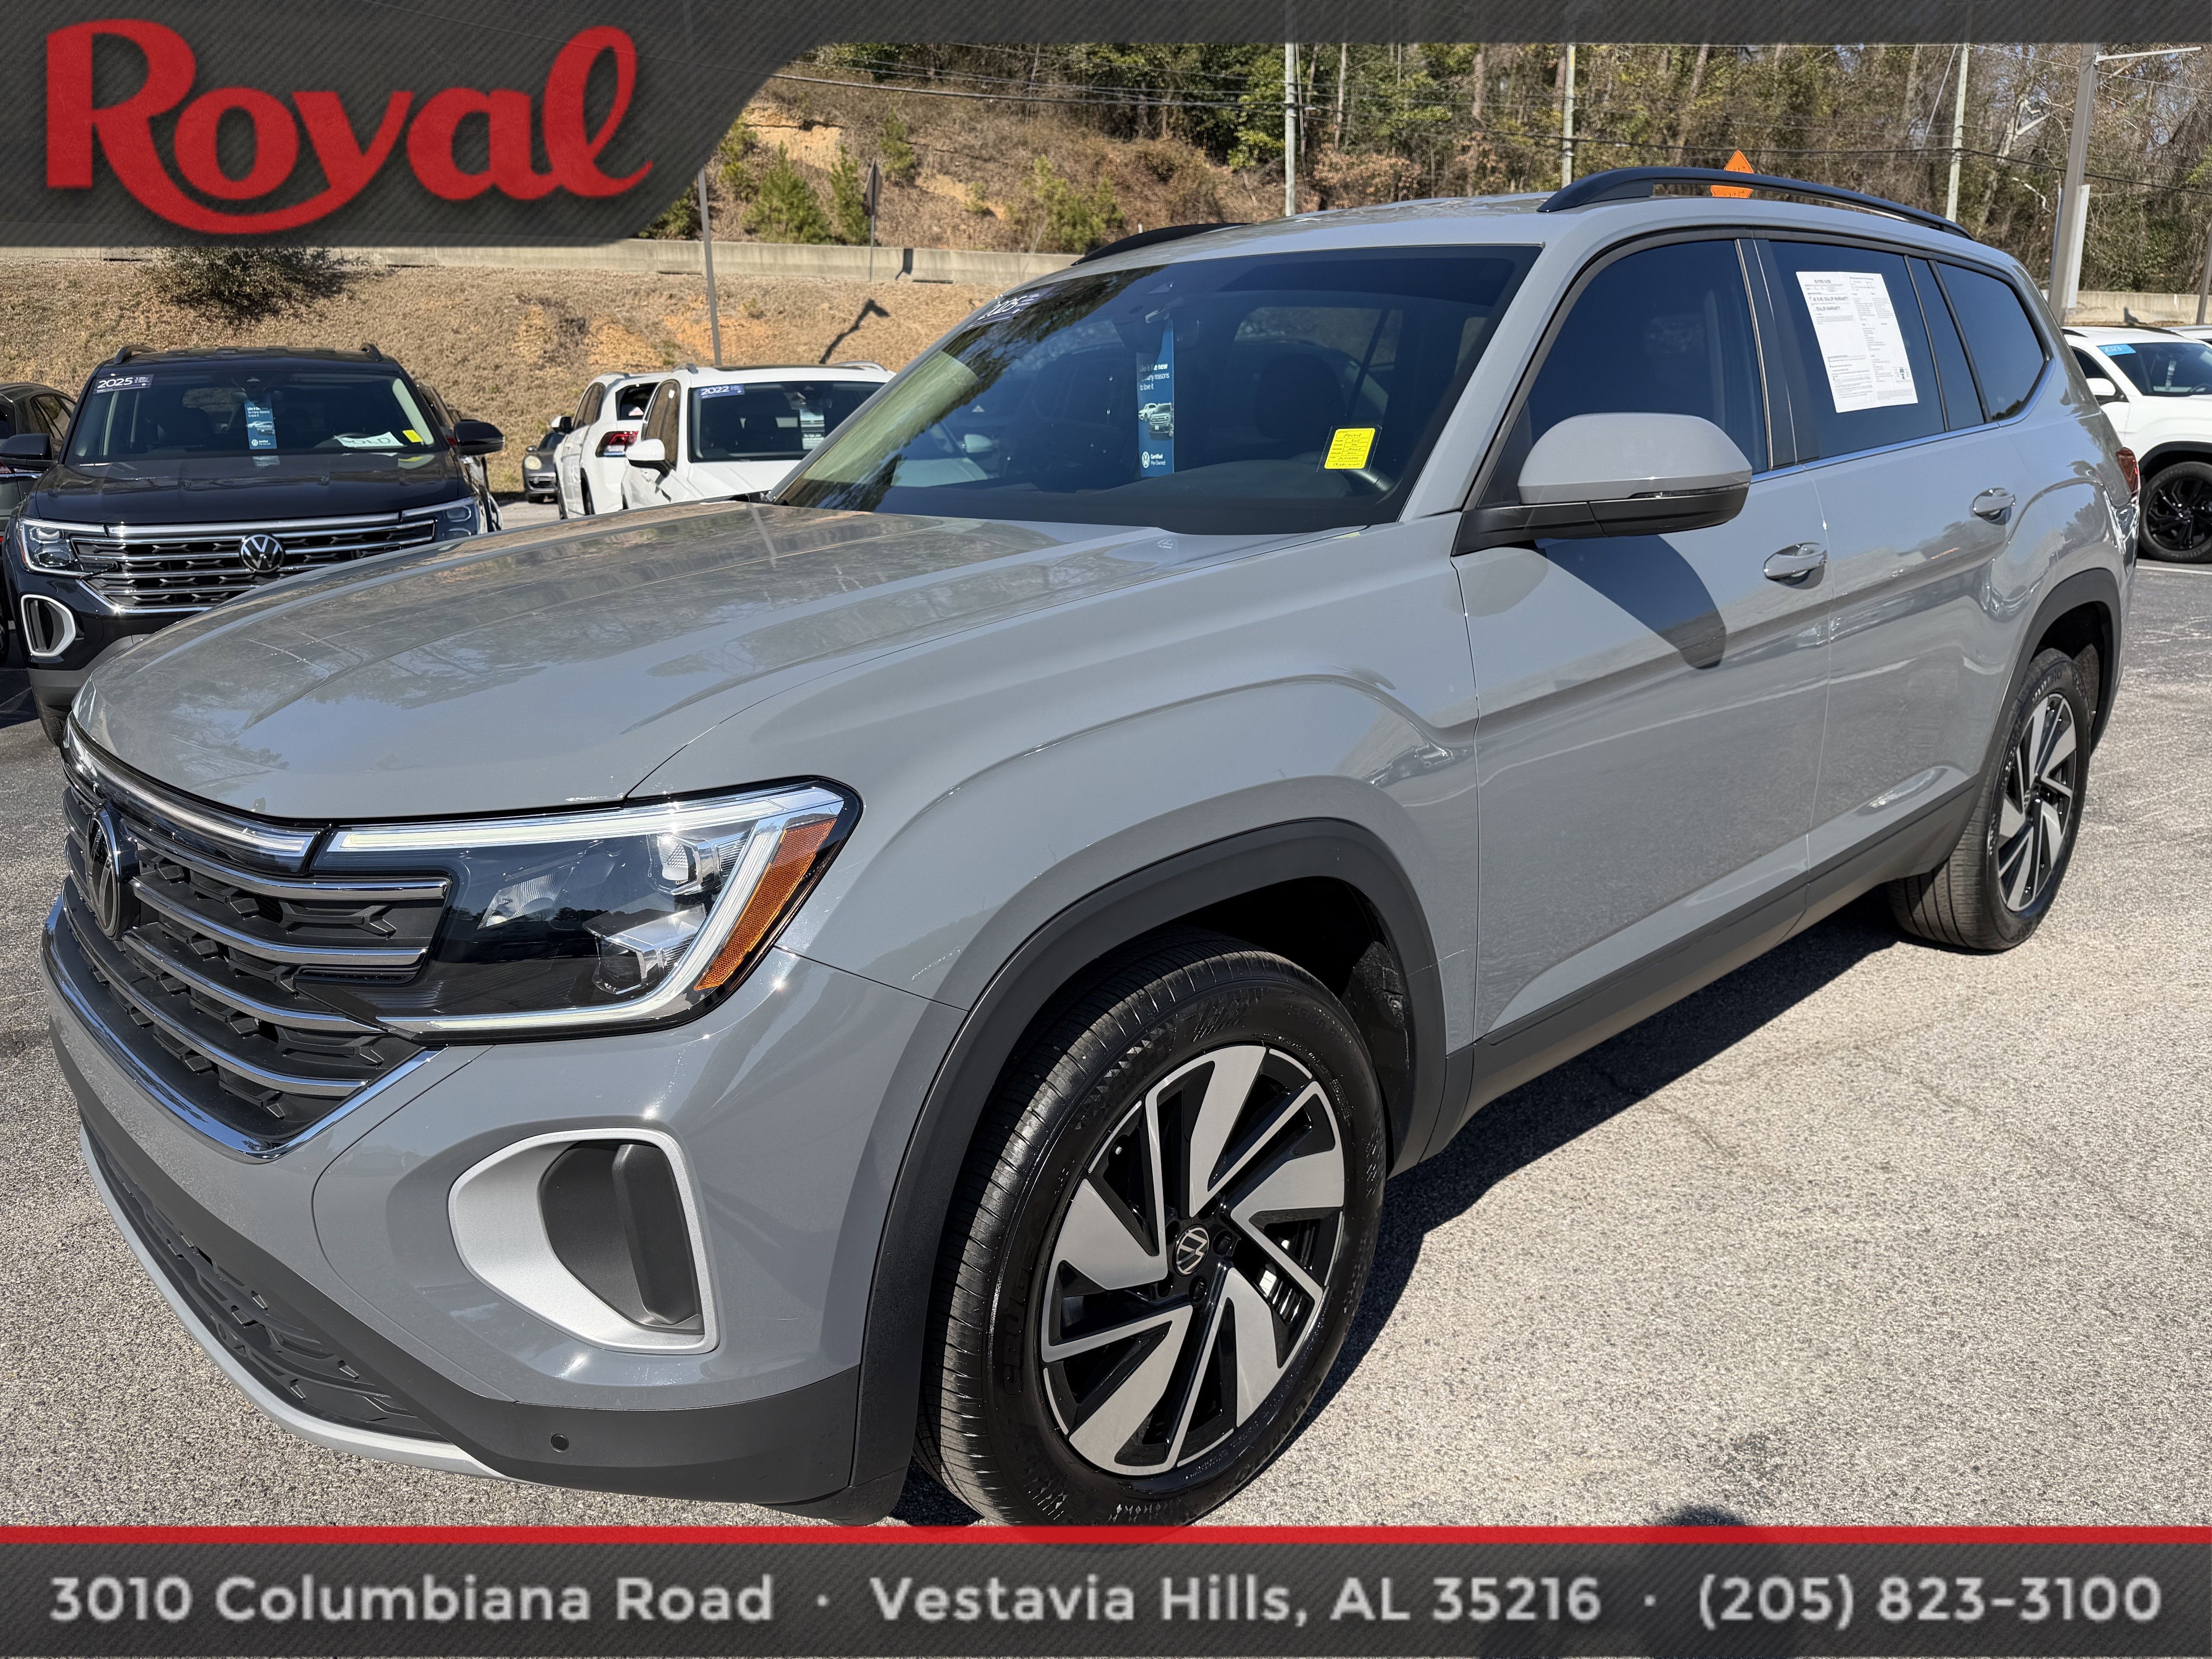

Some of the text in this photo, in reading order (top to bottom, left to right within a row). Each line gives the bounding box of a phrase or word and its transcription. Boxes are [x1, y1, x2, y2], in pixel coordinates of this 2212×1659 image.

[977, 295, 1028, 321] 2025
[97, 377, 133, 389] 2025
[701, 385, 730, 396] 2022
